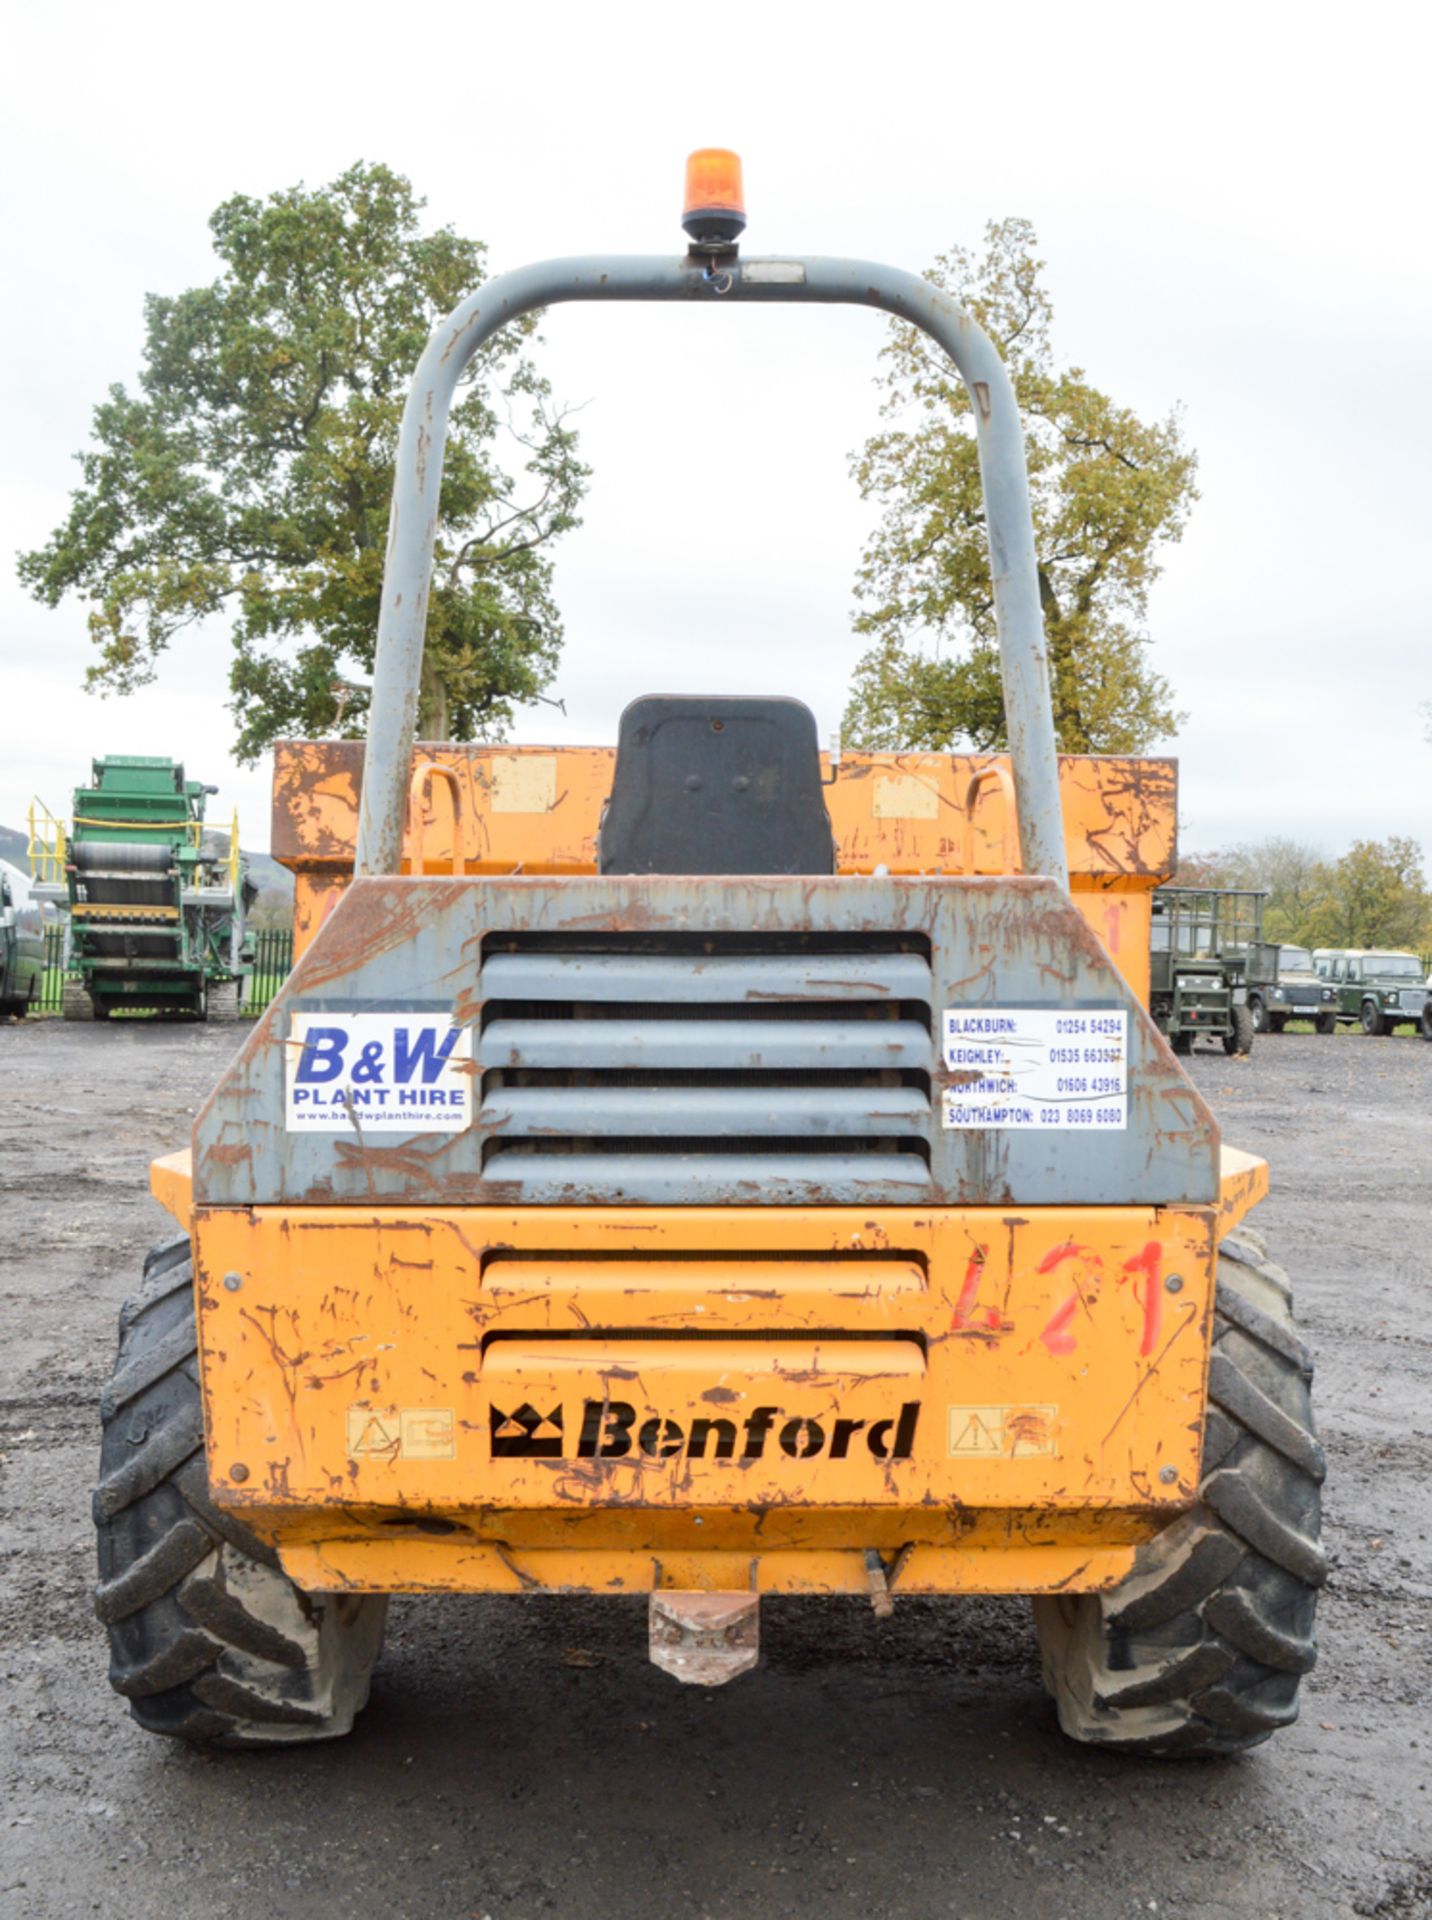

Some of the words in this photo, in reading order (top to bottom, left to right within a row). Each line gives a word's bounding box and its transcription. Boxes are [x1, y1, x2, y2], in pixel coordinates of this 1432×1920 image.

[949, 1018, 1018, 1034] BLACKBURN:
[1056, 1019, 1086, 1034] 01254
[1090, 1019, 1121, 1034] 54294
[294, 1027, 464, 1083] B&W
[949, 1048, 1005, 1064] KEIGHLEY:
[1050, 1048, 1080, 1063] 01535
[1057, 1077, 1087, 1092] 01606
[1091, 1077, 1121, 1092] 43916
[293, 1089, 390, 1105] PLANT
[400, 1089, 465, 1105] HIRE
[296, 1111, 463, 1121] www.badwplanthire.com
[949, 1108, 1034, 1123] SOUTHAMPTON:
[1040, 1108, 1060, 1123] 023
[577, 1400, 921, 1458] Benford
